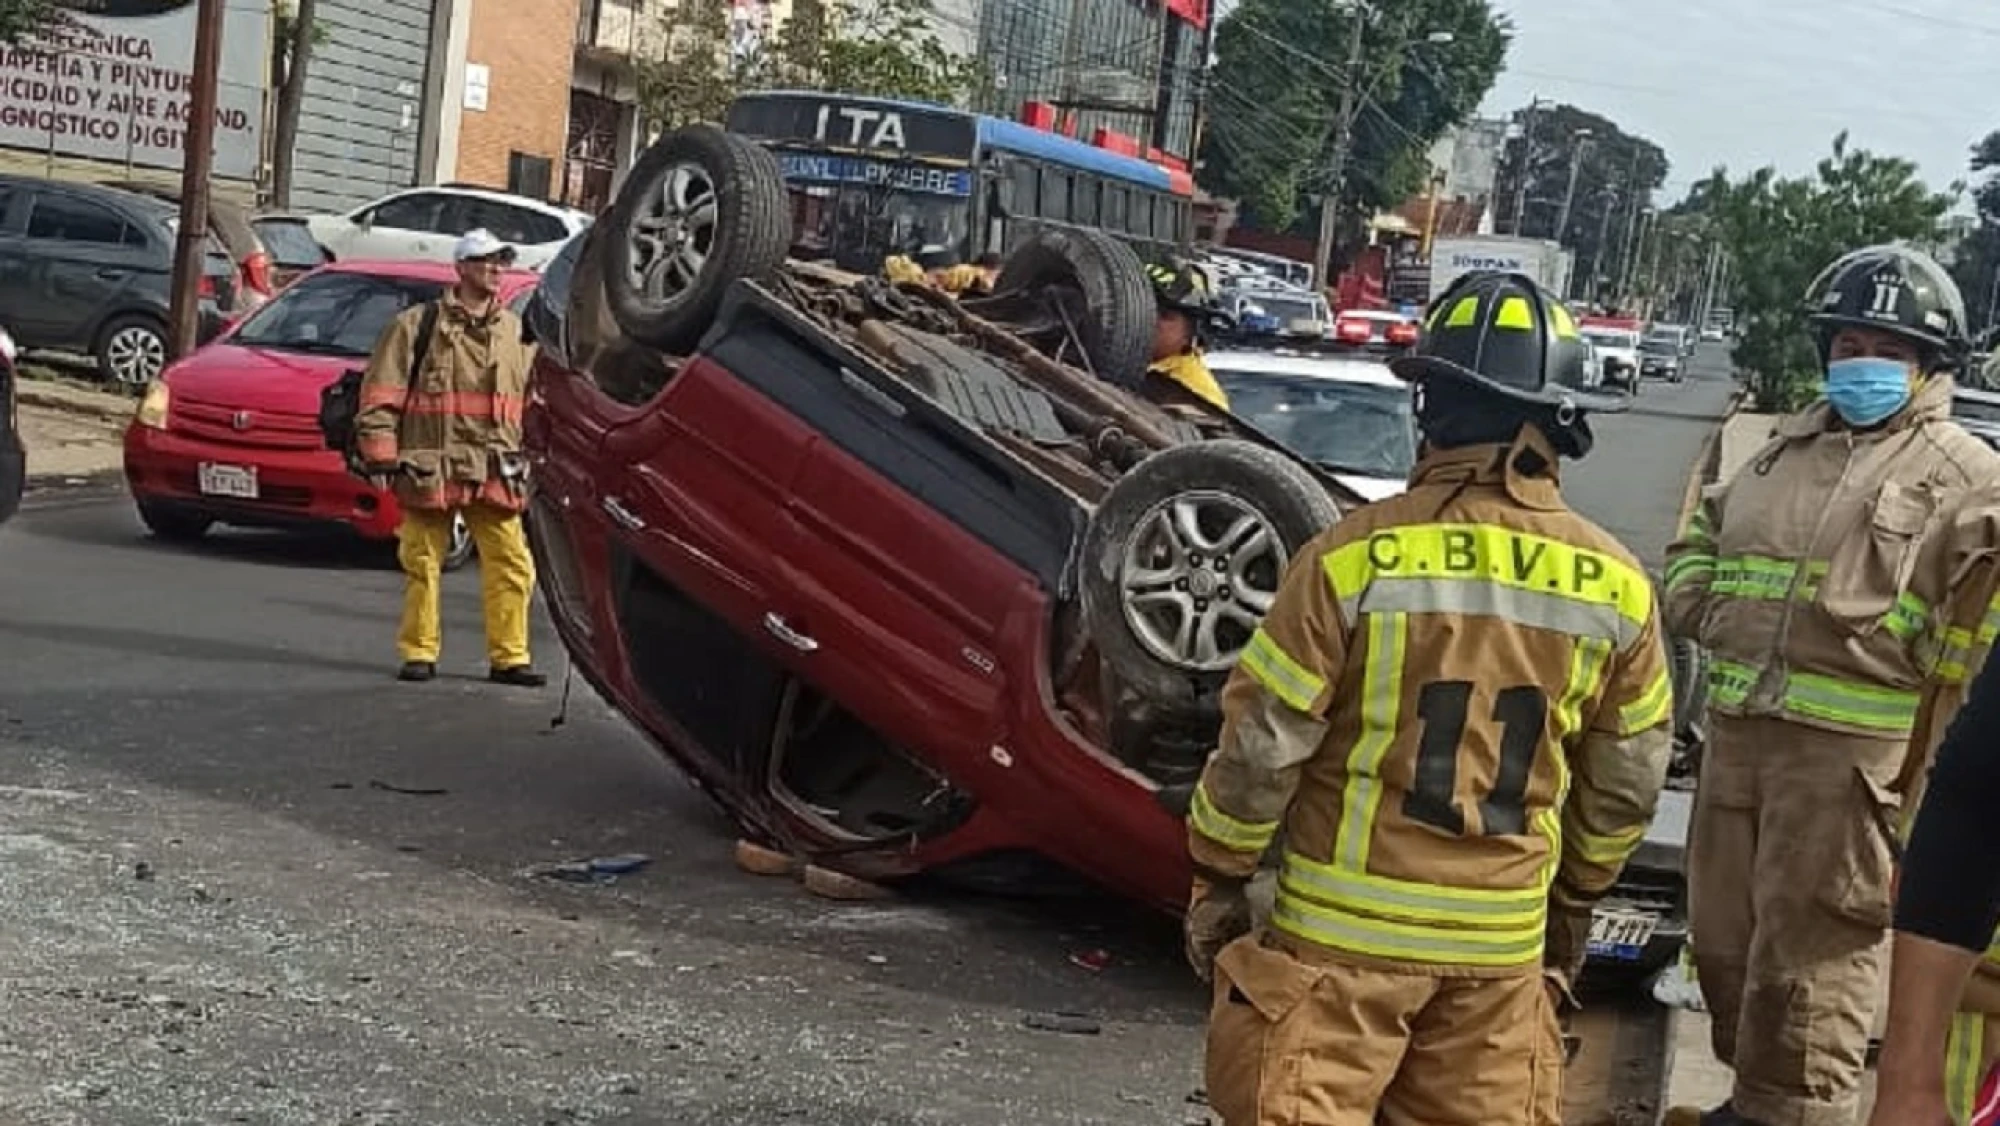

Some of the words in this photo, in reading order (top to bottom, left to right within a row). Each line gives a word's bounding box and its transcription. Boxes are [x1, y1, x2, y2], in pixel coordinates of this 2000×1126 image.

[90, 60, 103, 81] Y
[87, 88, 101, 109] Y
[107, 92, 156, 117] AIRE
[165, 101, 253, 133] ACND.
[1368, 530, 1620, 600] C.B.V.P.
[1402, 681, 1547, 835] 11
